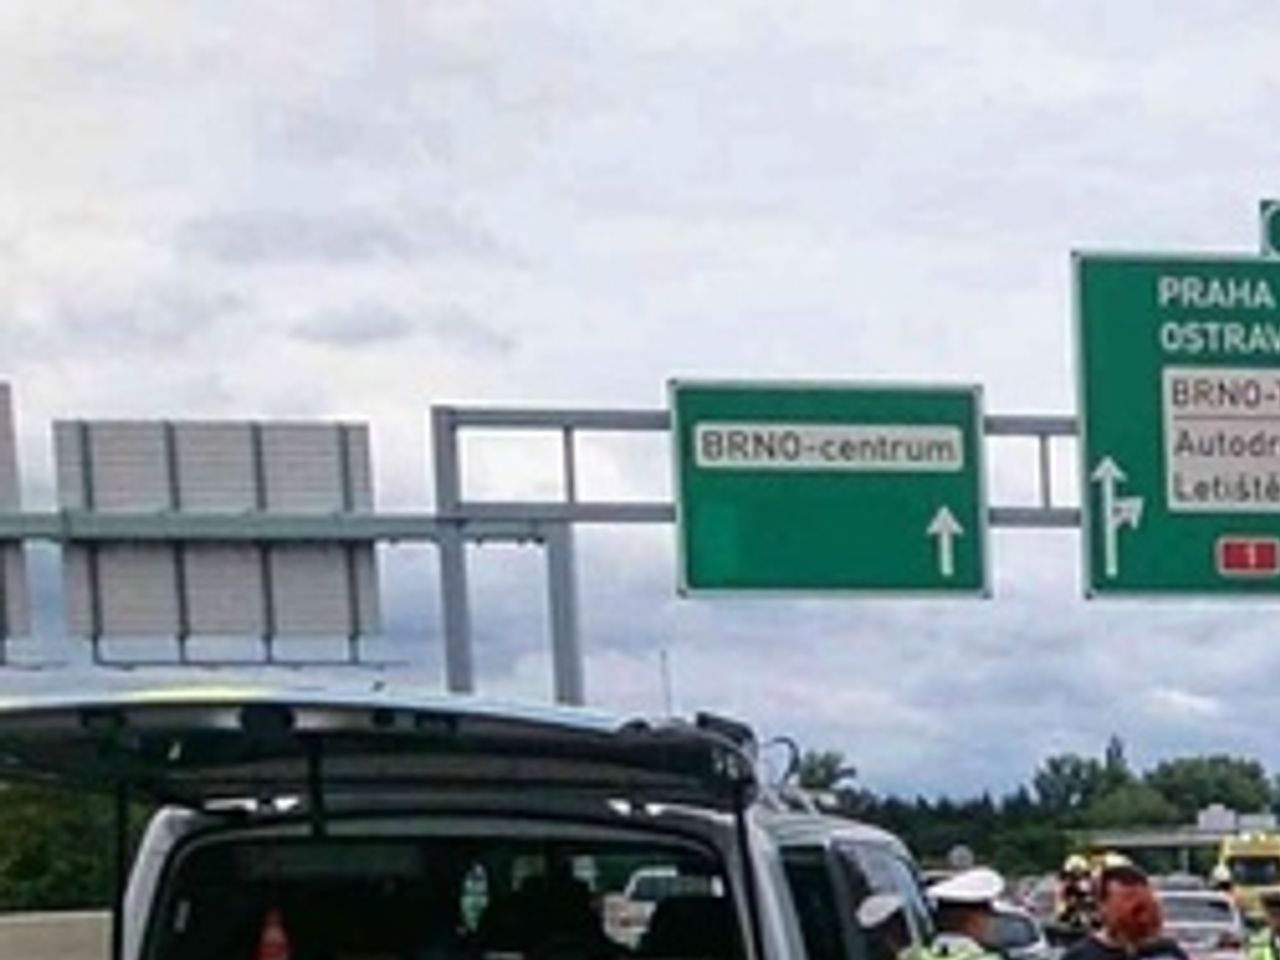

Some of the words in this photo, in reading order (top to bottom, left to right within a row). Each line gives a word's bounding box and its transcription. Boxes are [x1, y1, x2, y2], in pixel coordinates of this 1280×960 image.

[1157, 275, 1277, 309] PRAHA
[700, 431, 957, 464] BRNO-centrum
[1243, 545, 1257, 569] 1
